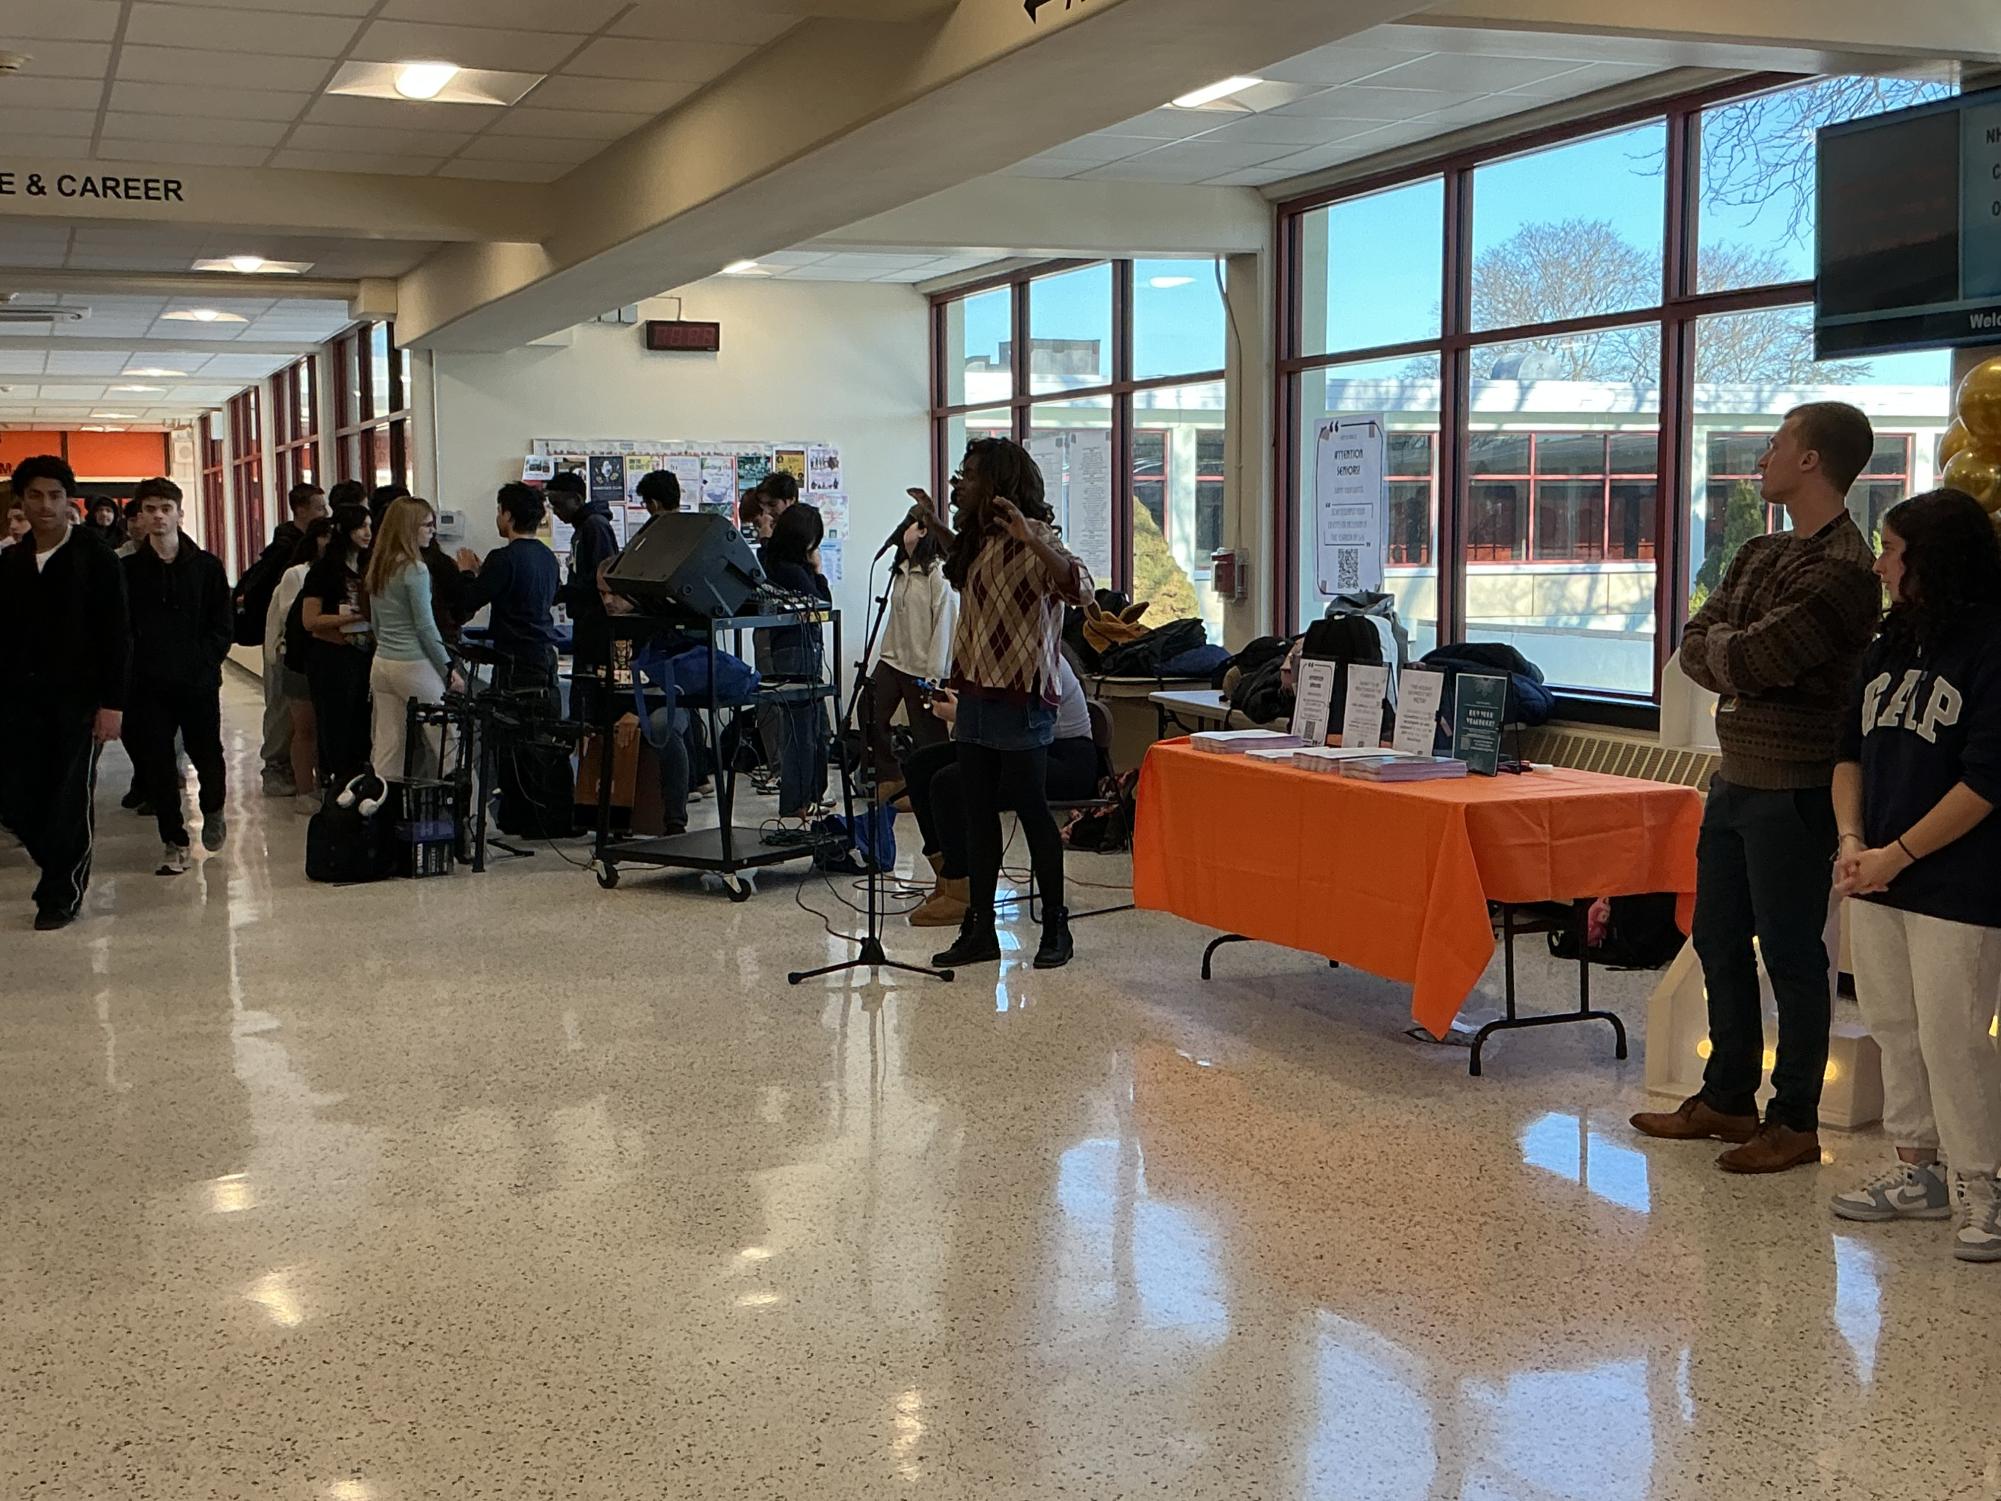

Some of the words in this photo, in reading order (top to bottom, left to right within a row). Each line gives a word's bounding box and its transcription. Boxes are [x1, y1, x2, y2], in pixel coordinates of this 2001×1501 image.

[26, 174, 47, 196] &
[57, 174, 184, 202] CAREER
[1862, 669, 1963, 744] GAP
